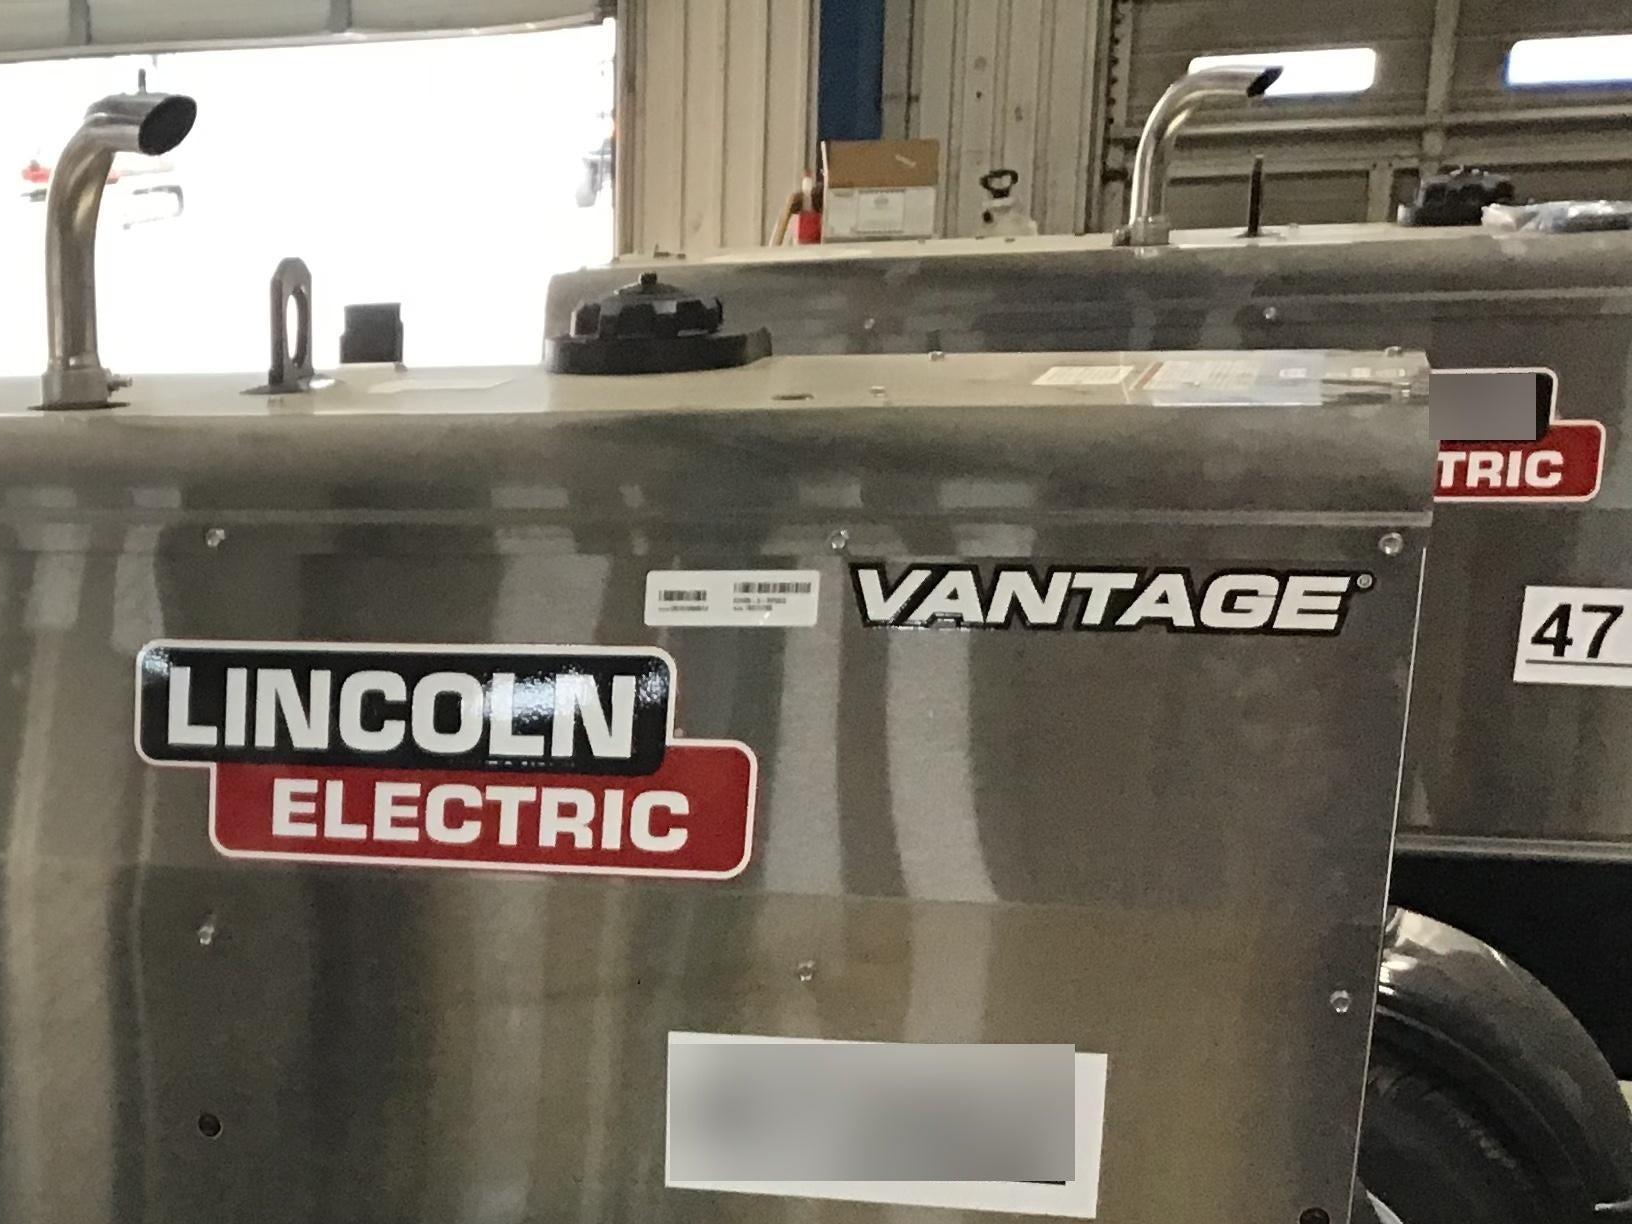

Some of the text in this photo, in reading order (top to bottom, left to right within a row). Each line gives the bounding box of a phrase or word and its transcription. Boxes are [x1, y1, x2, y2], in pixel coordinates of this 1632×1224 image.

[1530, 603, 1624, 659] 47
[167, 666, 636, 759] LINCOLN
[272, 777, 690, 852] ELECTRIC
